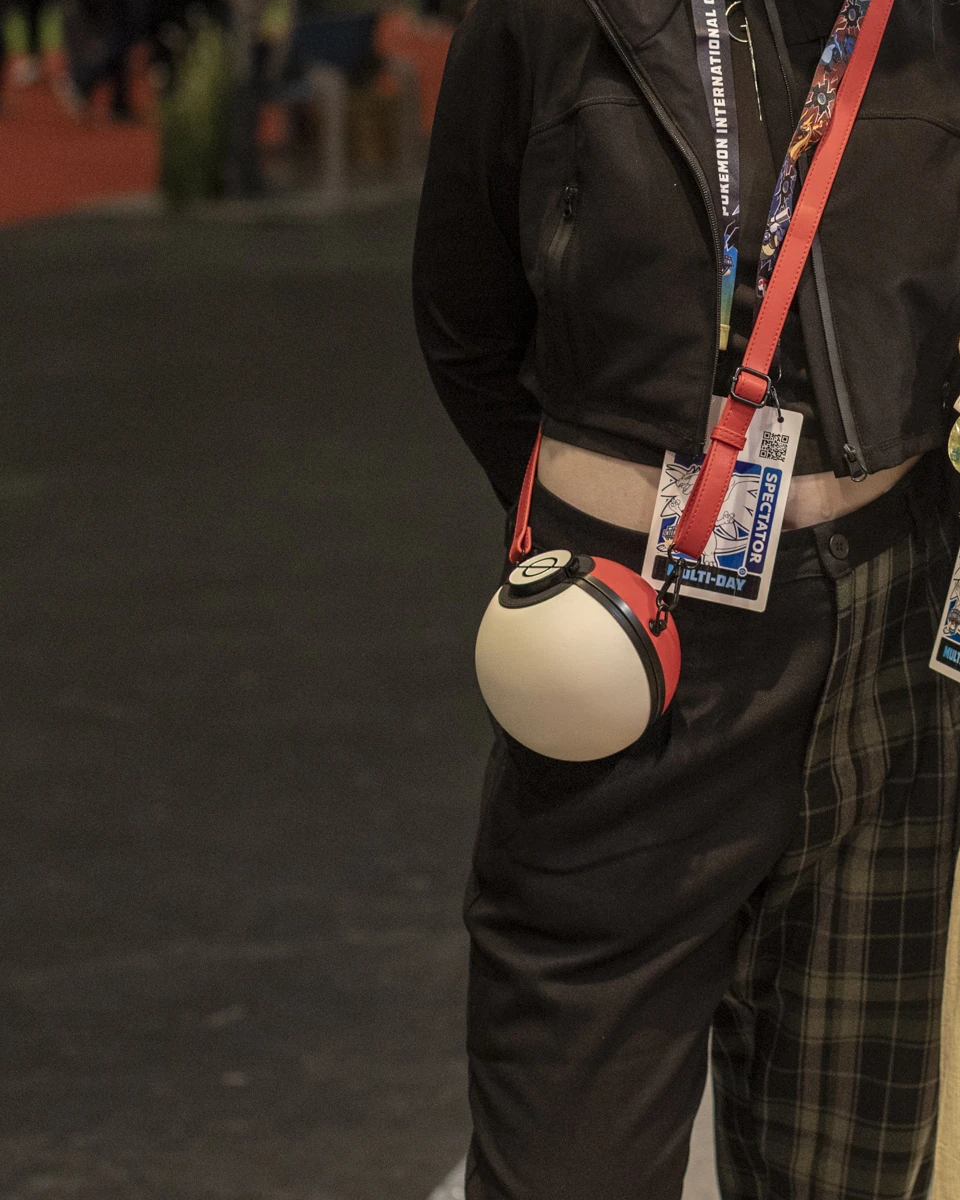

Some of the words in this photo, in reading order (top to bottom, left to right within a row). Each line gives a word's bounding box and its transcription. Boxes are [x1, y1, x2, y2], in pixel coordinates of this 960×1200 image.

[705, 9, 728, 134] INTERNATIONAL
[749, 472, 778, 564] SPECTATOR
[667, 564, 747, 591] ULTI-DAY
